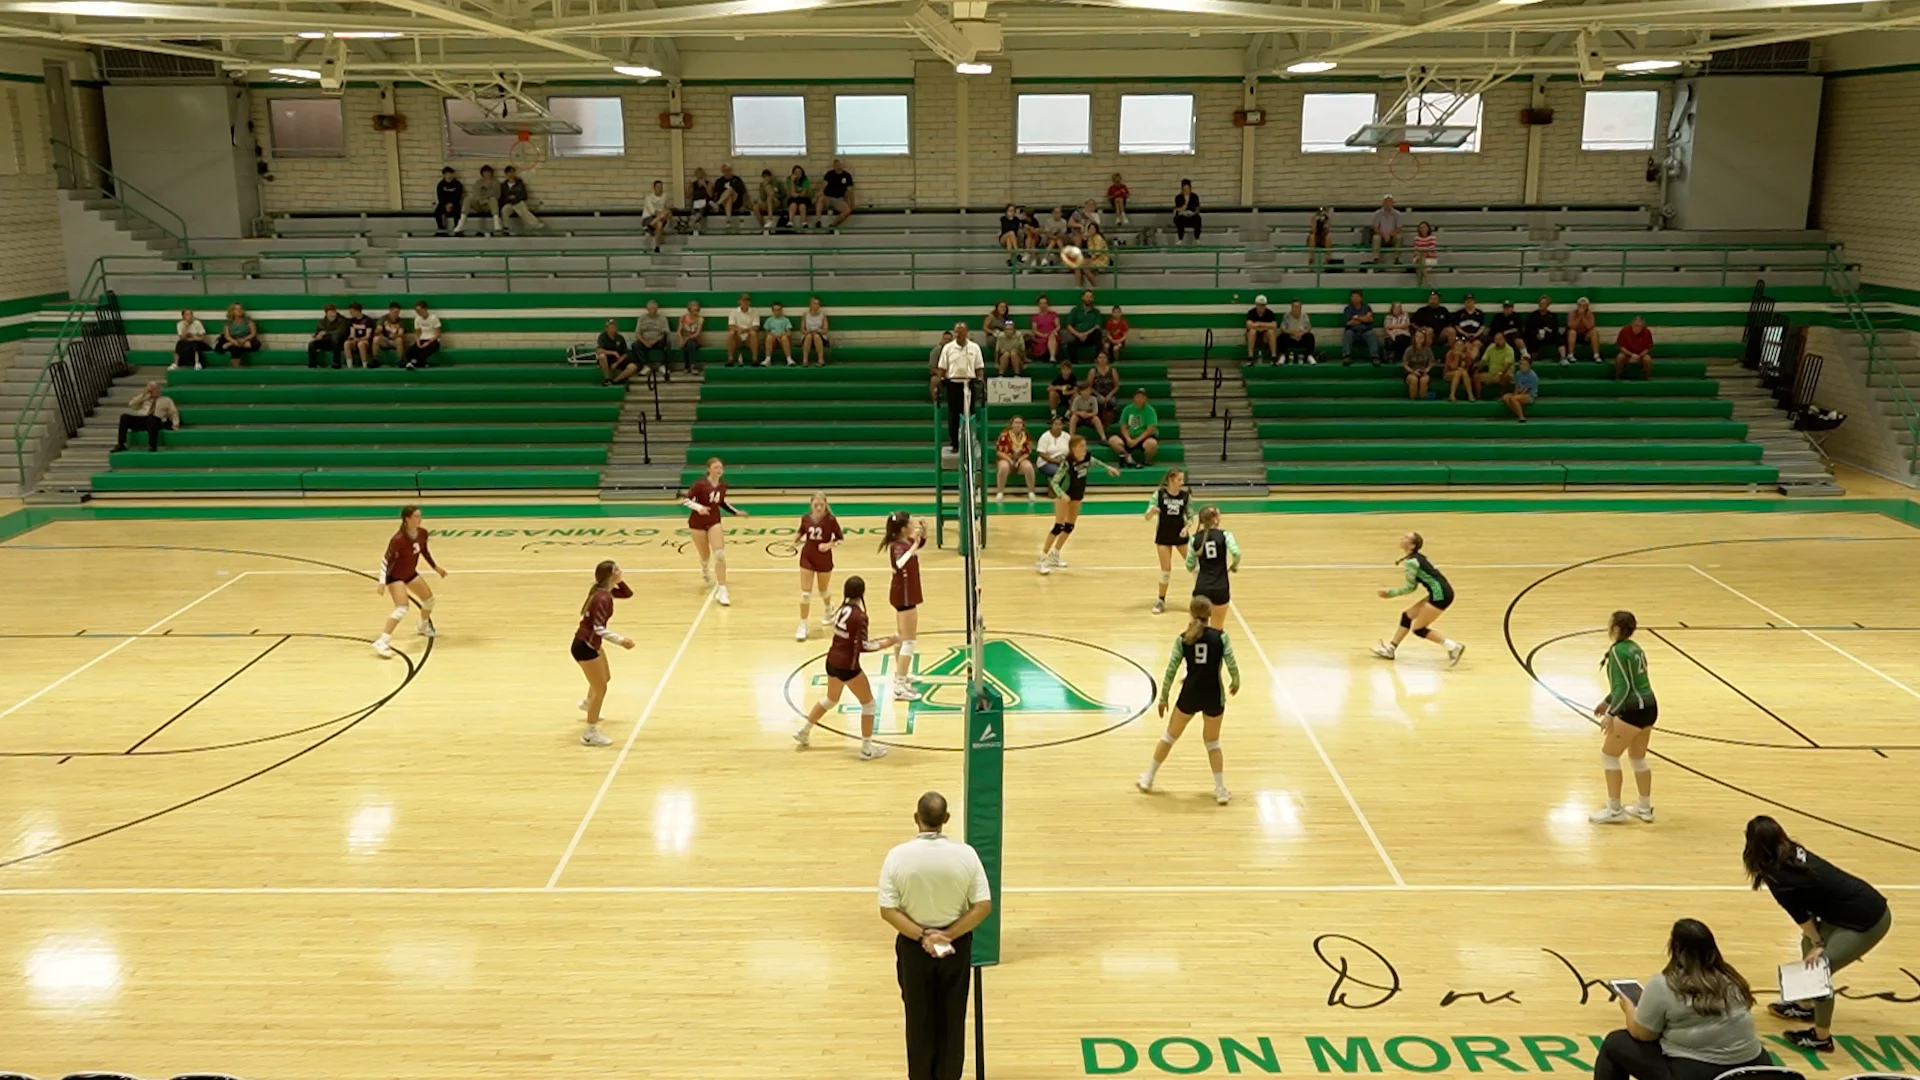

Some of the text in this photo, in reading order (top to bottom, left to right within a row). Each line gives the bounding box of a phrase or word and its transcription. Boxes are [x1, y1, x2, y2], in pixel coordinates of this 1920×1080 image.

[808, 526, 823, 540] 22
[412, 542, 421, 554] 3
[1205, 541, 1217, 558] 6
[1195, 643, 1208, 664] 9
[1080, 1036, 1282, 1074] DON
[1304, 1035, 1603, 1074] MORR
